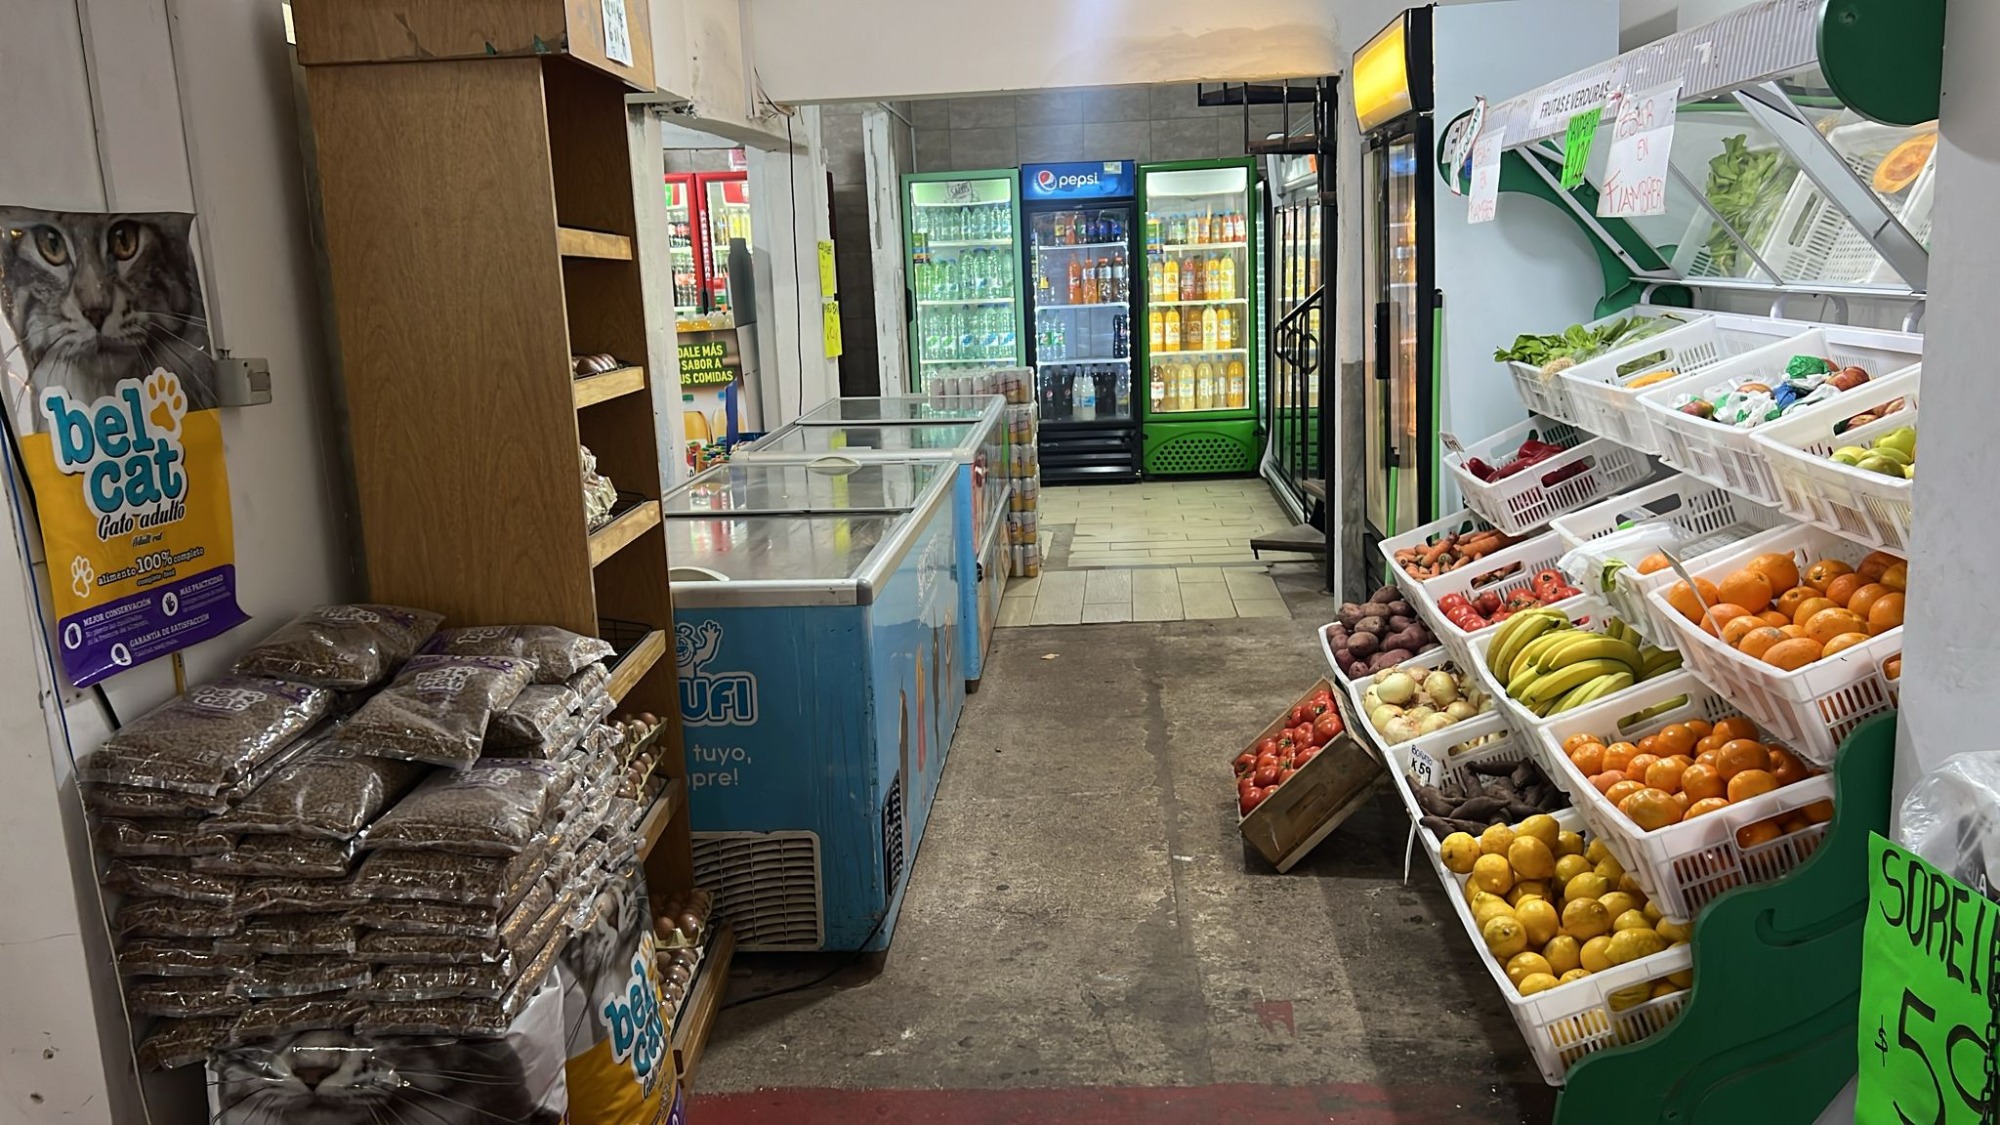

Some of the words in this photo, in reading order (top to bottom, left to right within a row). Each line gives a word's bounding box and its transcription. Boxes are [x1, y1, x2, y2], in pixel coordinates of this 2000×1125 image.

[1571, 80, 1610, 110] VERDURAS
[1059, 172, 1098, 188] pepsi
[678, 346, 700, 359] DALE
[702, 342, 723, 357] MÁS
[681, 358, 713, 371] SABOR
[714, 357, 722, 369] A
[692, 370, 734, 384] COMIDAS
[46, 387, 155, 465] bel
[90, 438, 182, 514] cat
[98, 513, 134, 540] Gato
[139, 500, 185, 529] adulto
[98, 567, 137, 585] alimento
[136, 551, 173, 575] 100%
[173, 547, 204, 564] completo
[83, 612, 105, 627] MEJOR
[105, 596, 152, 619] CONSERVACIÓN
[129, 629, 162, 647] GARANTÍA
[161, 626, 171, 636] DE
[693, 743, 751, 767] tuyo,
[1418, 762, 1431, 783] 59
[604, 959, 652, 1057] bel
